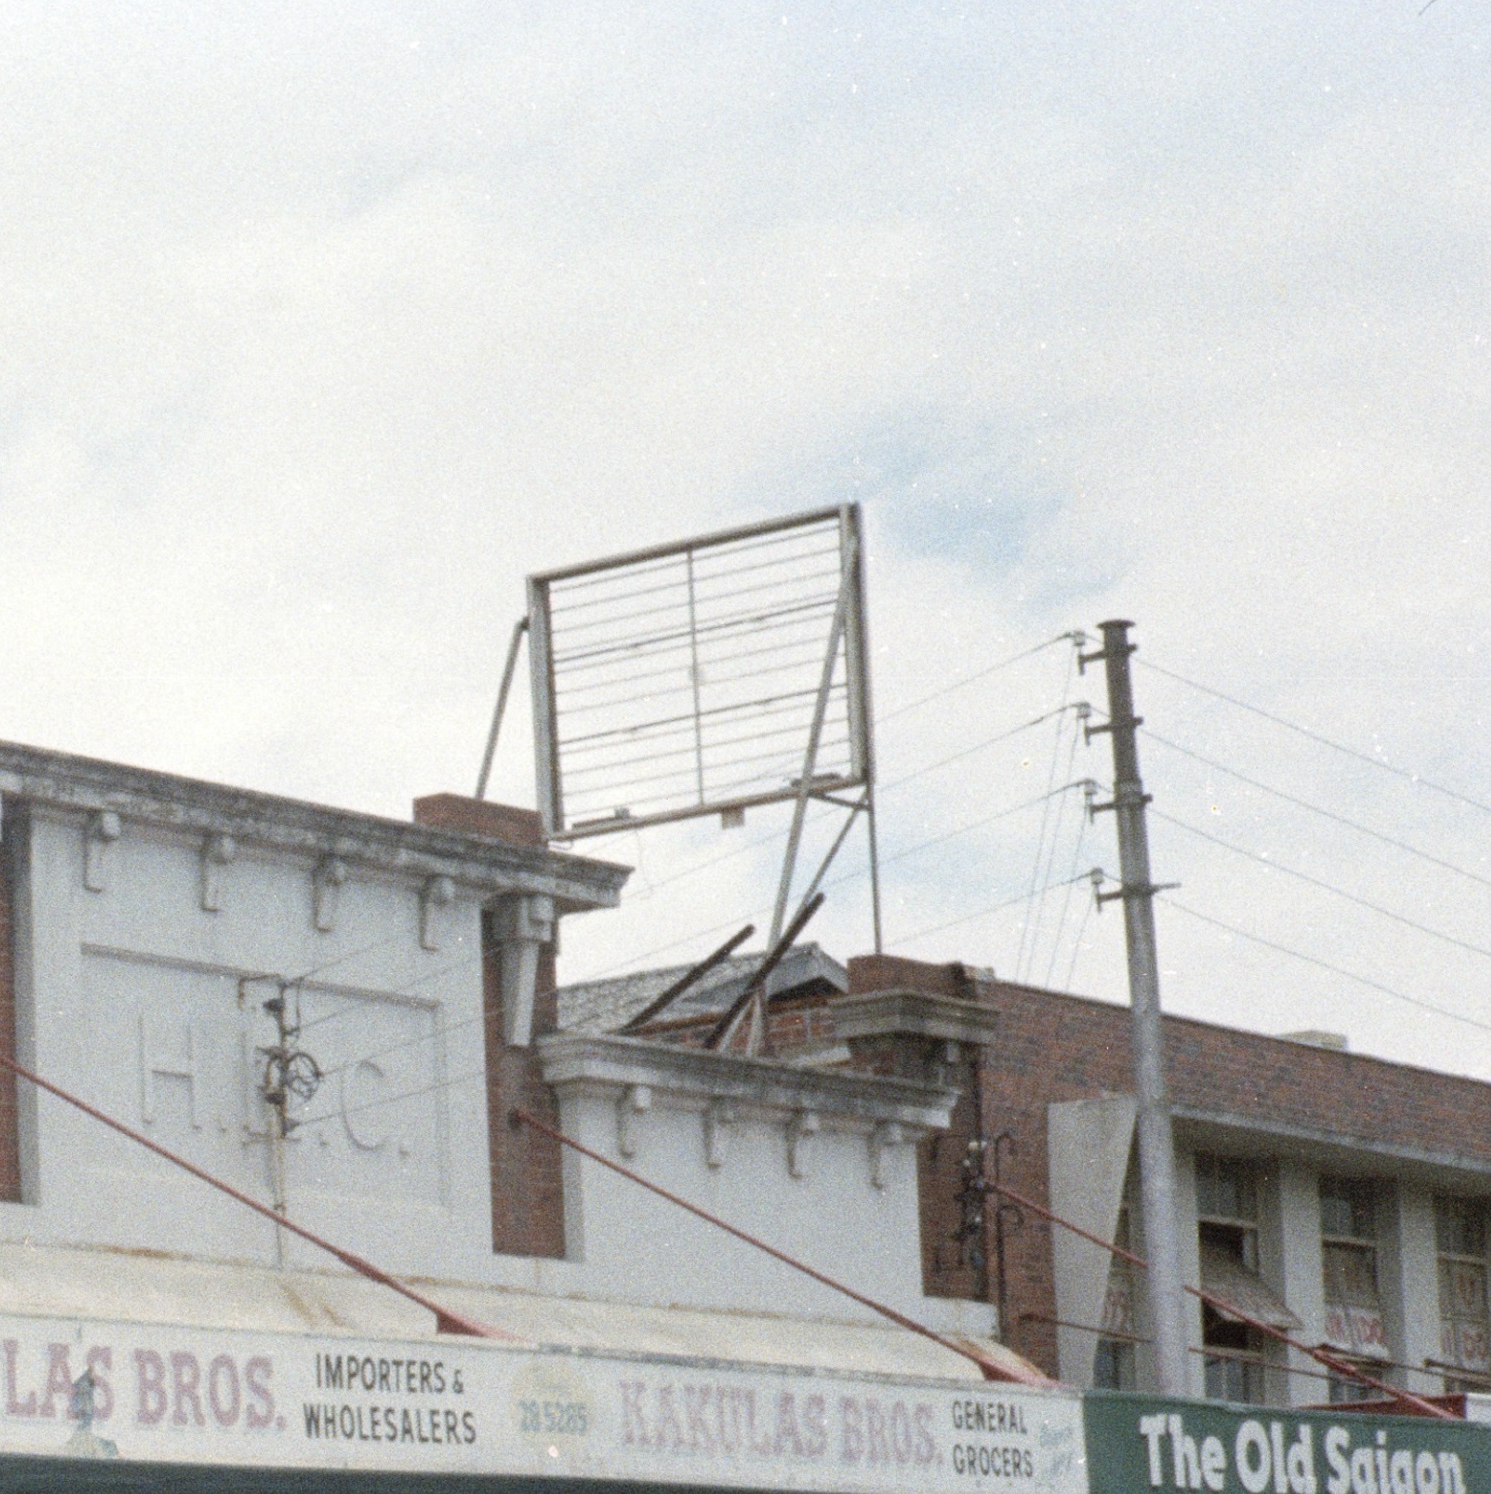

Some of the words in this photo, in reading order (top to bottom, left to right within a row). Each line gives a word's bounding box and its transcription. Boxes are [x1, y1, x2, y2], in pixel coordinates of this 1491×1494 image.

[133, 1347, 286, 1432] BROS.
[315, 1351, 447, 1394] IMPORTERS
[302, 1402, 479, 1445] WHOLESALERS
[618, 1380, 829, 1459] KAKULAS
[838, 1397, 944, 1468] BROS.
[952, 1399, 1028, 1435] GENERAL
[952, 1444, 1034, 1479] GROCERS
[1139, 1413, 1227, 1491] The
